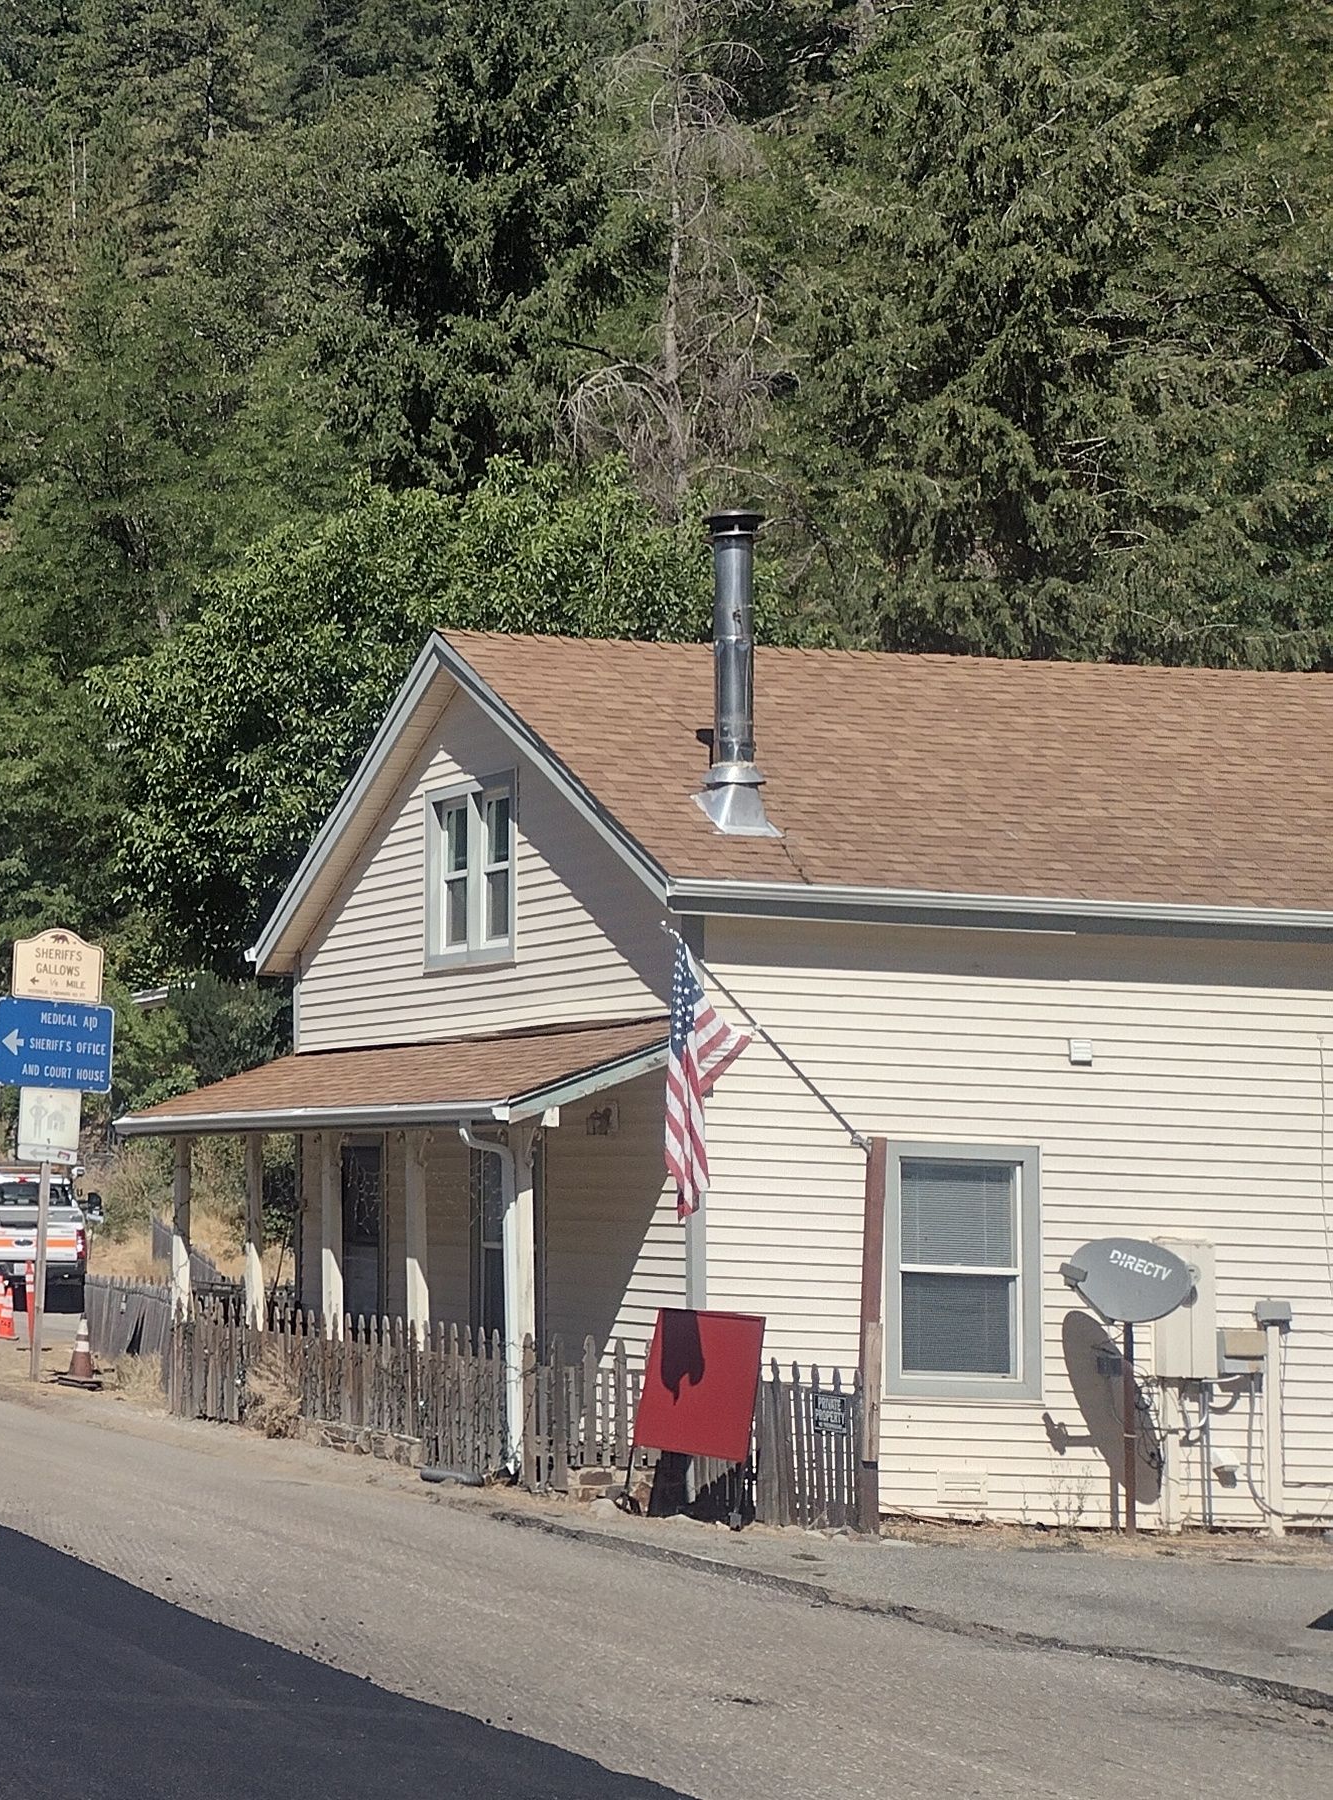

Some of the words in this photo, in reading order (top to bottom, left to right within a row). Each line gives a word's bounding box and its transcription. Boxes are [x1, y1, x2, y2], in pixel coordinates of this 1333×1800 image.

[35, 947, 82, 962] SHERIFFS
[36, 963, 80, 977] GALLOWS
[66, 980, 86, 990] MILE
[40, 1011, 77, 1027] MEDICAL
[83, 1016, 98, 1029] AID
[29, 1037, 72, 1053] SHERIFF'S
[76, 1042, 107, 1056] OFFICE
[21, 1063, 40, 1077] AND
[44, 1066, 72, 1080] COURT
[76, 1069, 105, 1083] HOUSE
[1109, 1249, 1172, 1281] DIRECTV
[817, 1396, 842, 1412] PRIVATE
[814, 1408, 845, 1425] PROPERTY
